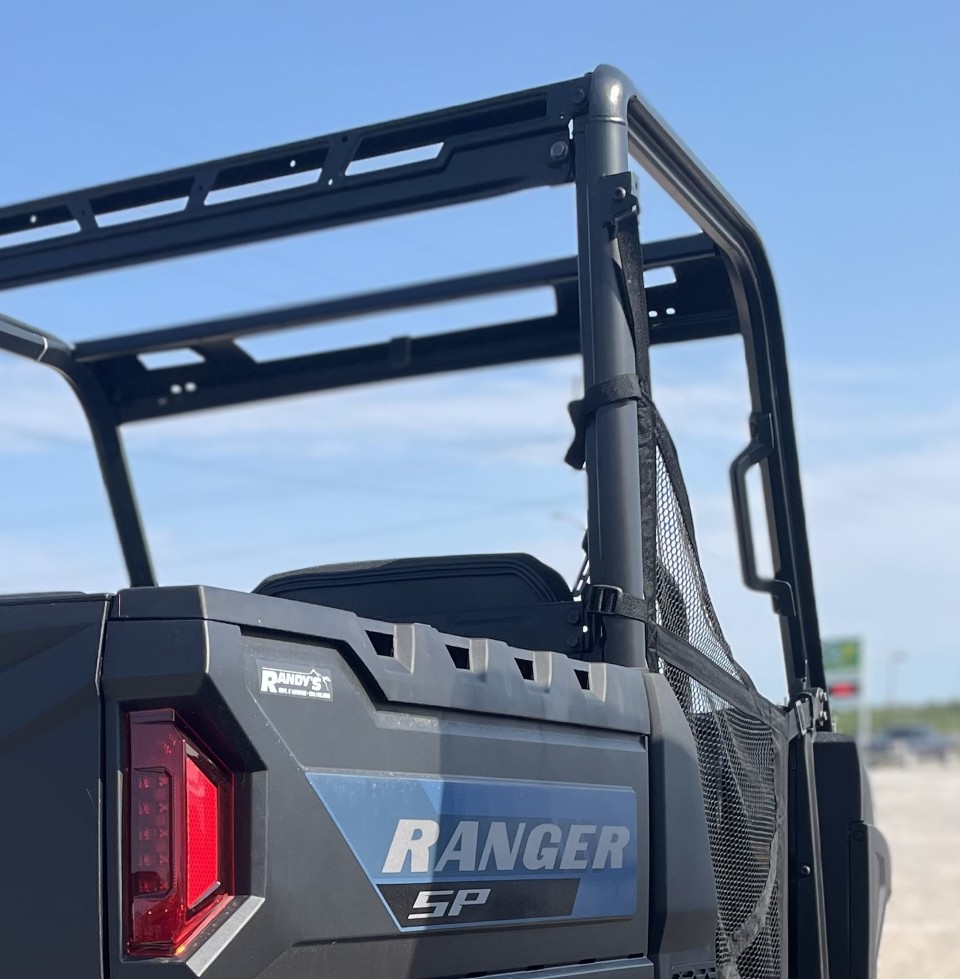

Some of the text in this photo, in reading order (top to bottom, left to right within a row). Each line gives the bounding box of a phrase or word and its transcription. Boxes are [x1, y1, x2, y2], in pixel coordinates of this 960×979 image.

[261, 669, 321, 693] RANDY'S
[381, 819, 630, 873] RANGER
[407, 888, 491, 920] SP
